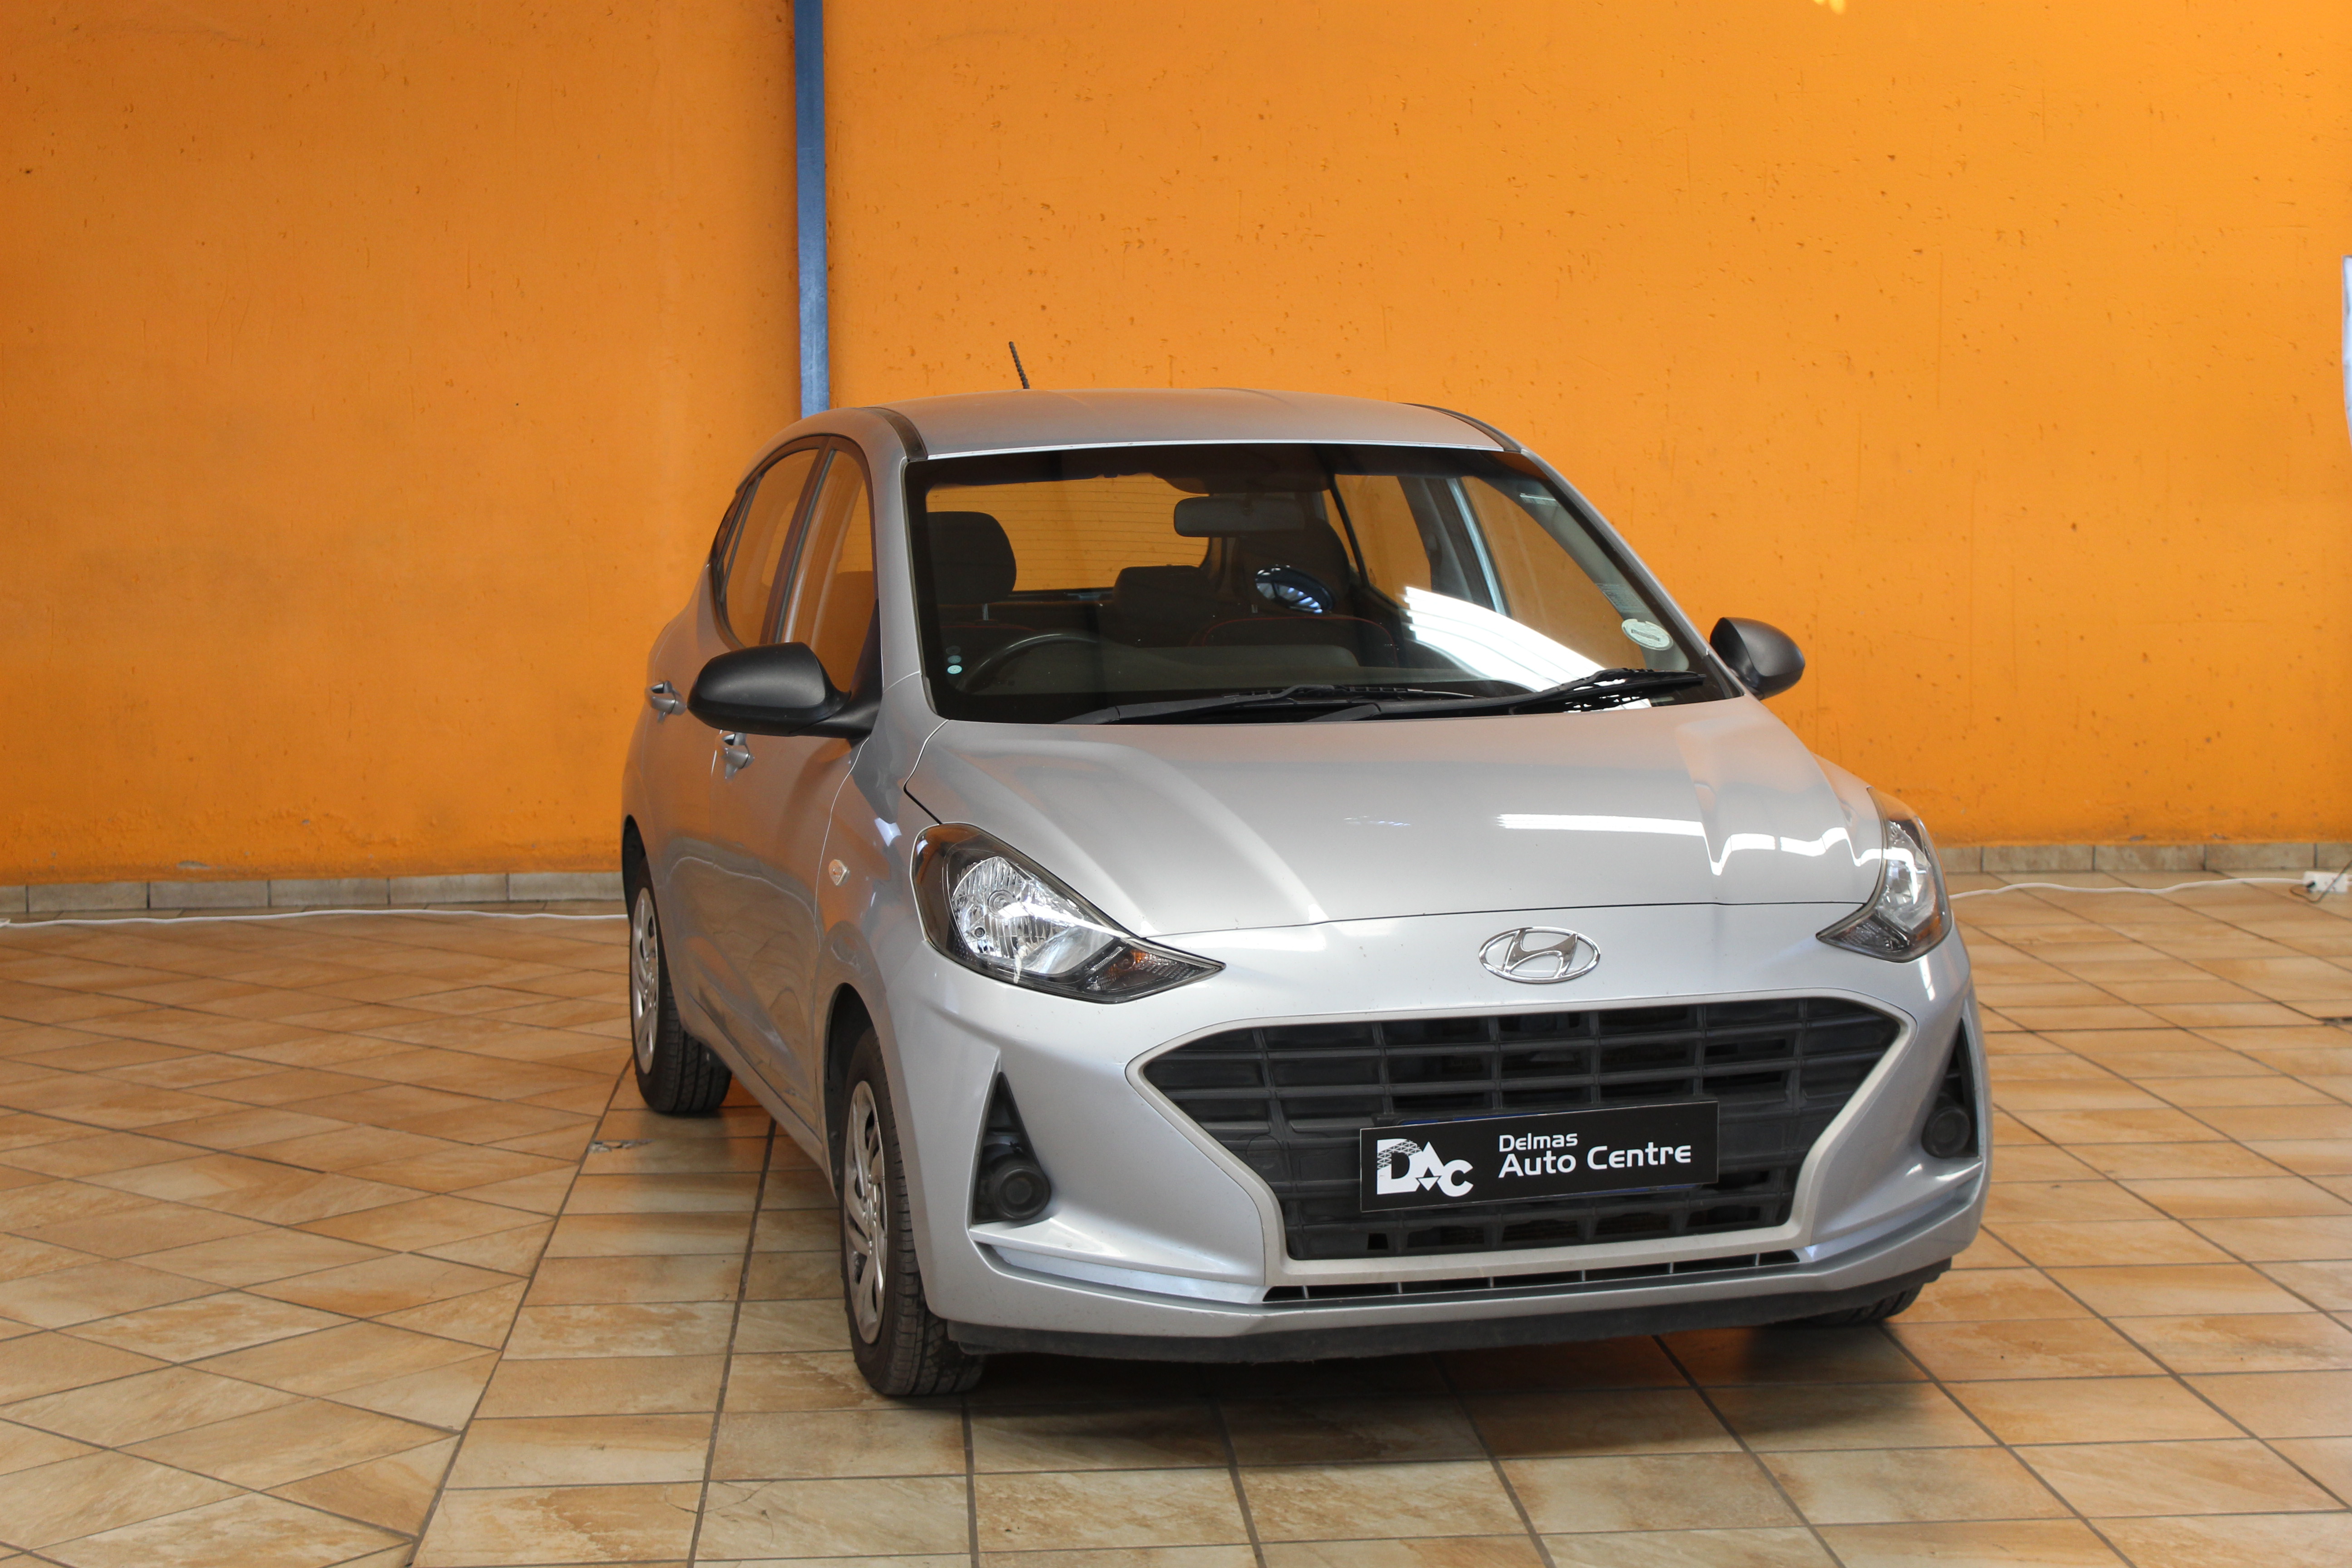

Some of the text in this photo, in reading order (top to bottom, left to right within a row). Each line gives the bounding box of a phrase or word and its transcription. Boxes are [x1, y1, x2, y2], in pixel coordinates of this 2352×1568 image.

[1499, 1133, 1578, 1152] Delmas
[1498, 1142, 1691, 1178] Auto Centre
